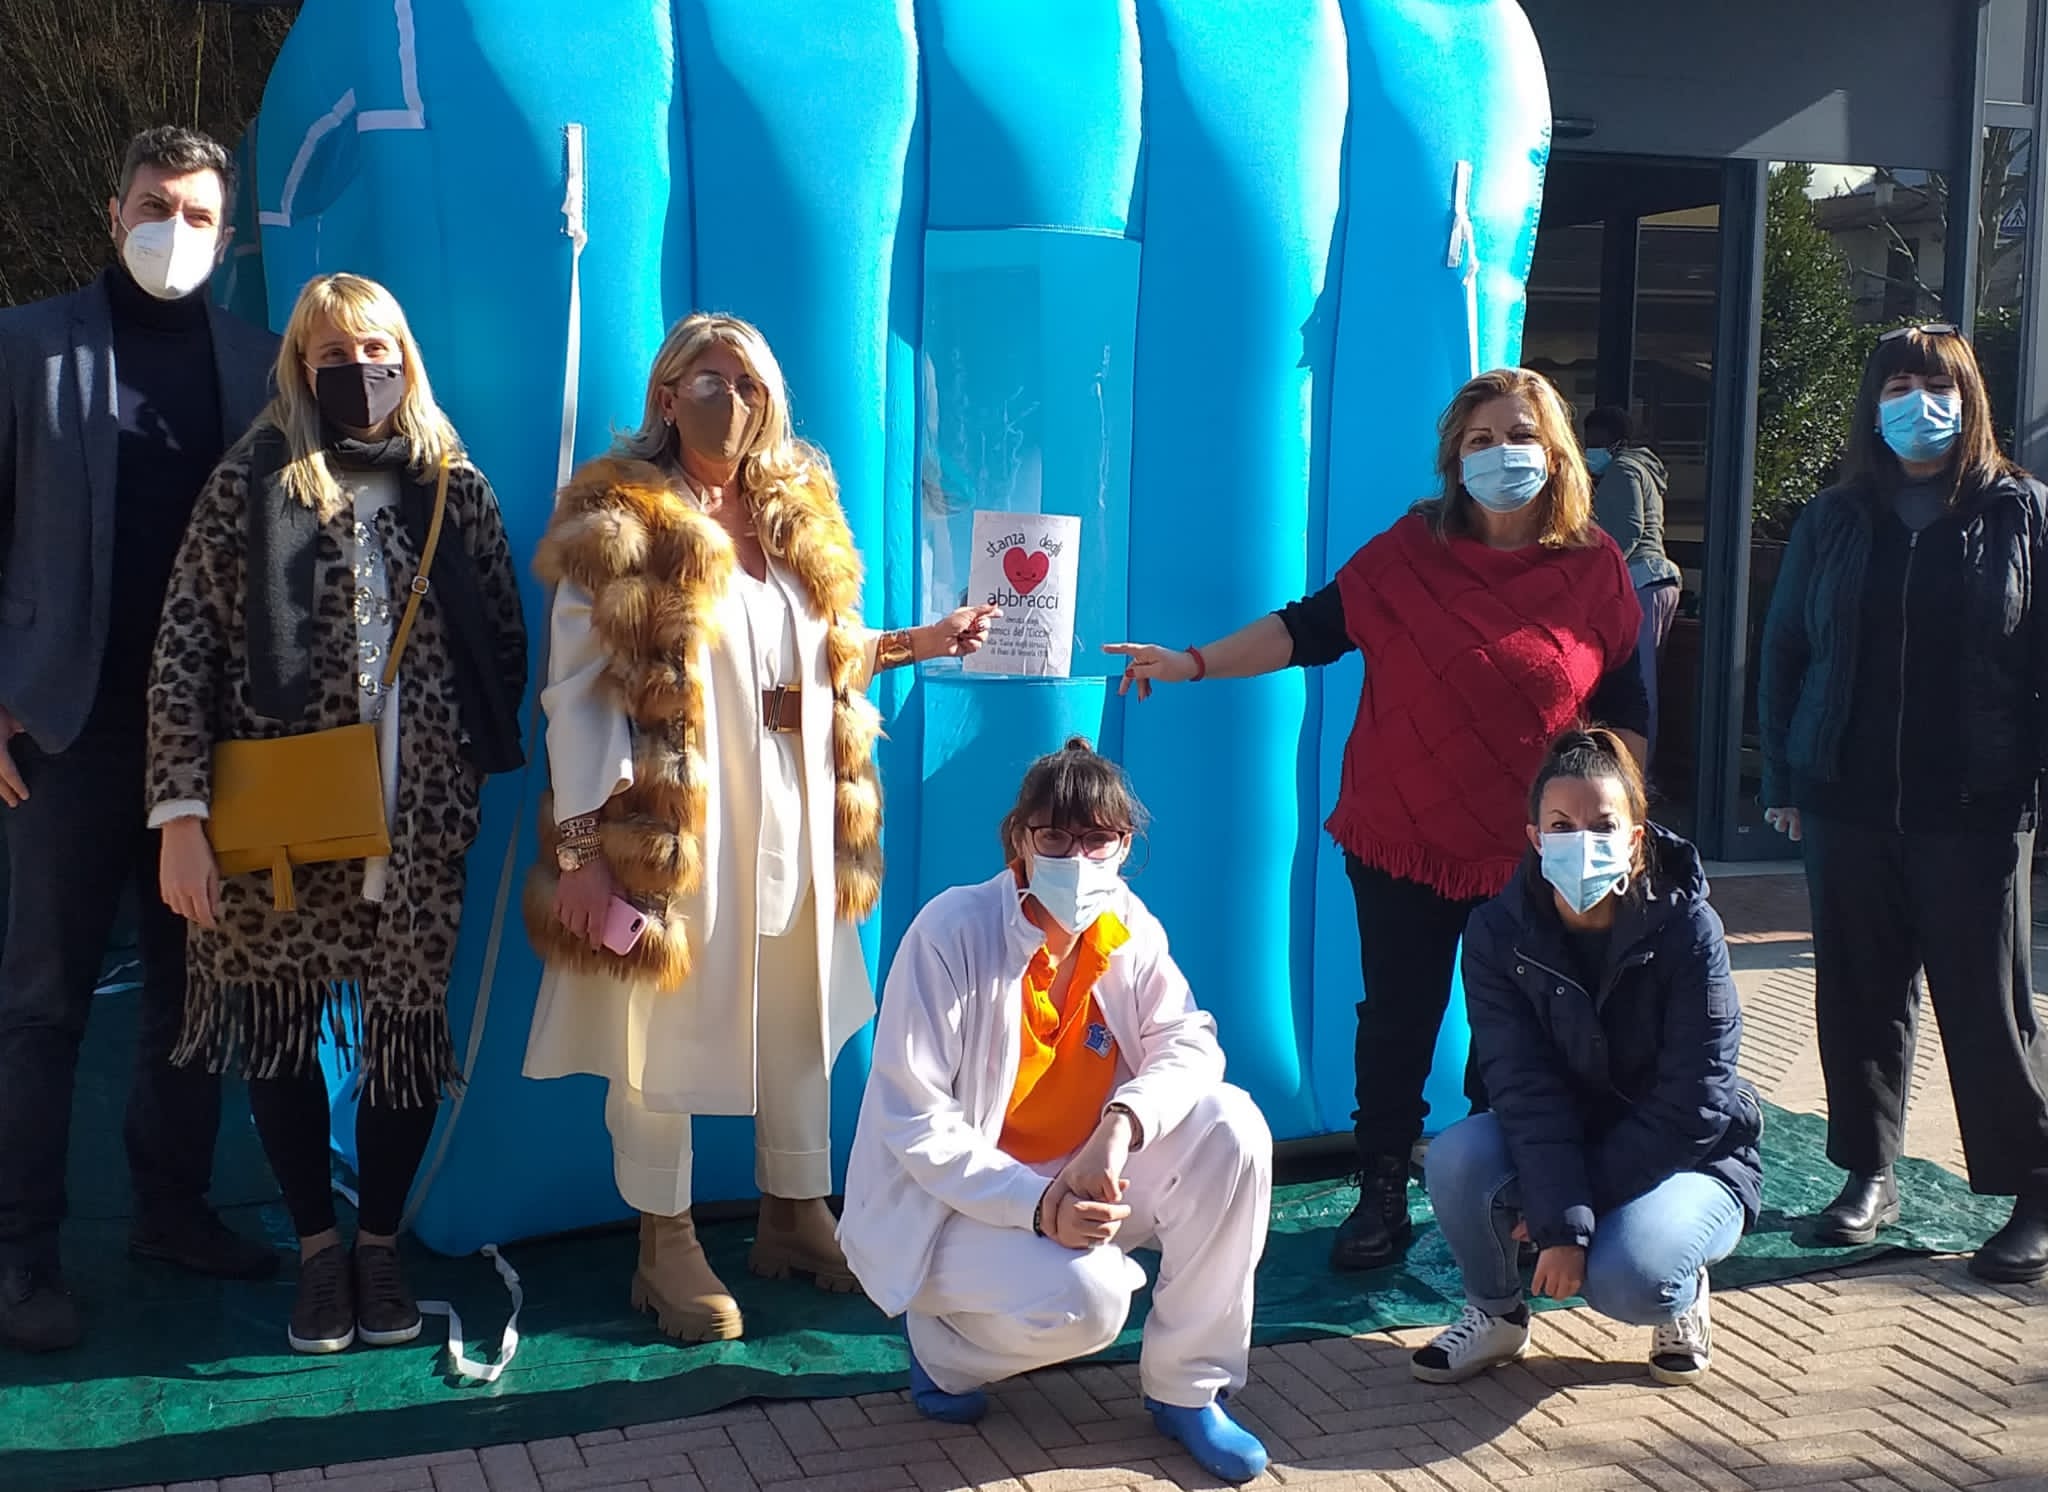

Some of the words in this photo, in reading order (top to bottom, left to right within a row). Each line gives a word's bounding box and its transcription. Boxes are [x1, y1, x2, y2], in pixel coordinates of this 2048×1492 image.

[986, 532, 1026, 558] stanza
[1039, 533, 1064, 558] degli
[987, 588, 1059, 610] abbracci
